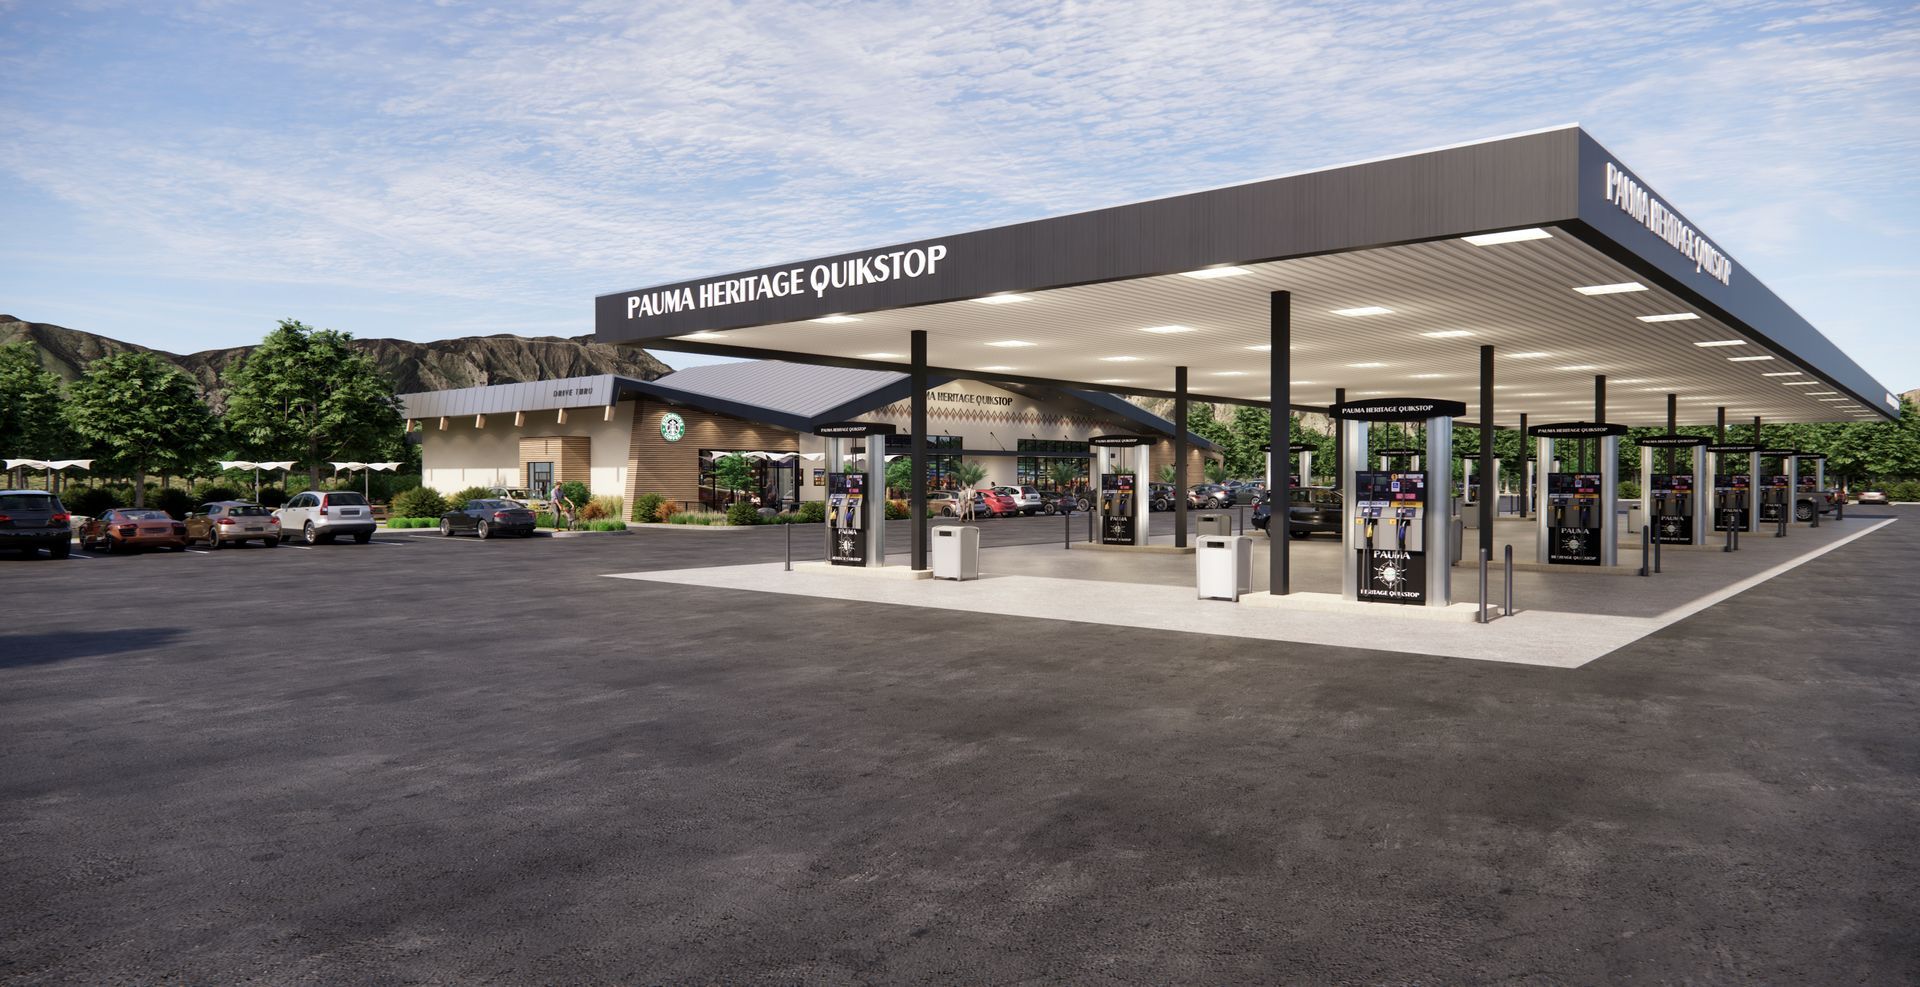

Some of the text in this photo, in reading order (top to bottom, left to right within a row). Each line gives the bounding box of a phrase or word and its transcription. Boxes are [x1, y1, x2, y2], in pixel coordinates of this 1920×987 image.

[1606, 162, 1731, 286] PAUMA HERITAGE QUIKSTOP
[627, 244, 947, 319] PAUMA HERITAGE QUIKSTOP
[553, 387, 593, 398] DRIVE THRU
[938, 392, 975, 403] HERITAGE
[976, 395, 1013, 406] QUIKSTOP
[1398, 405, 1433, 413] QUIKSTOP
[664, 431, 682, 441] COFFEE
[1374, 550, 1411, 560] PAUMA
